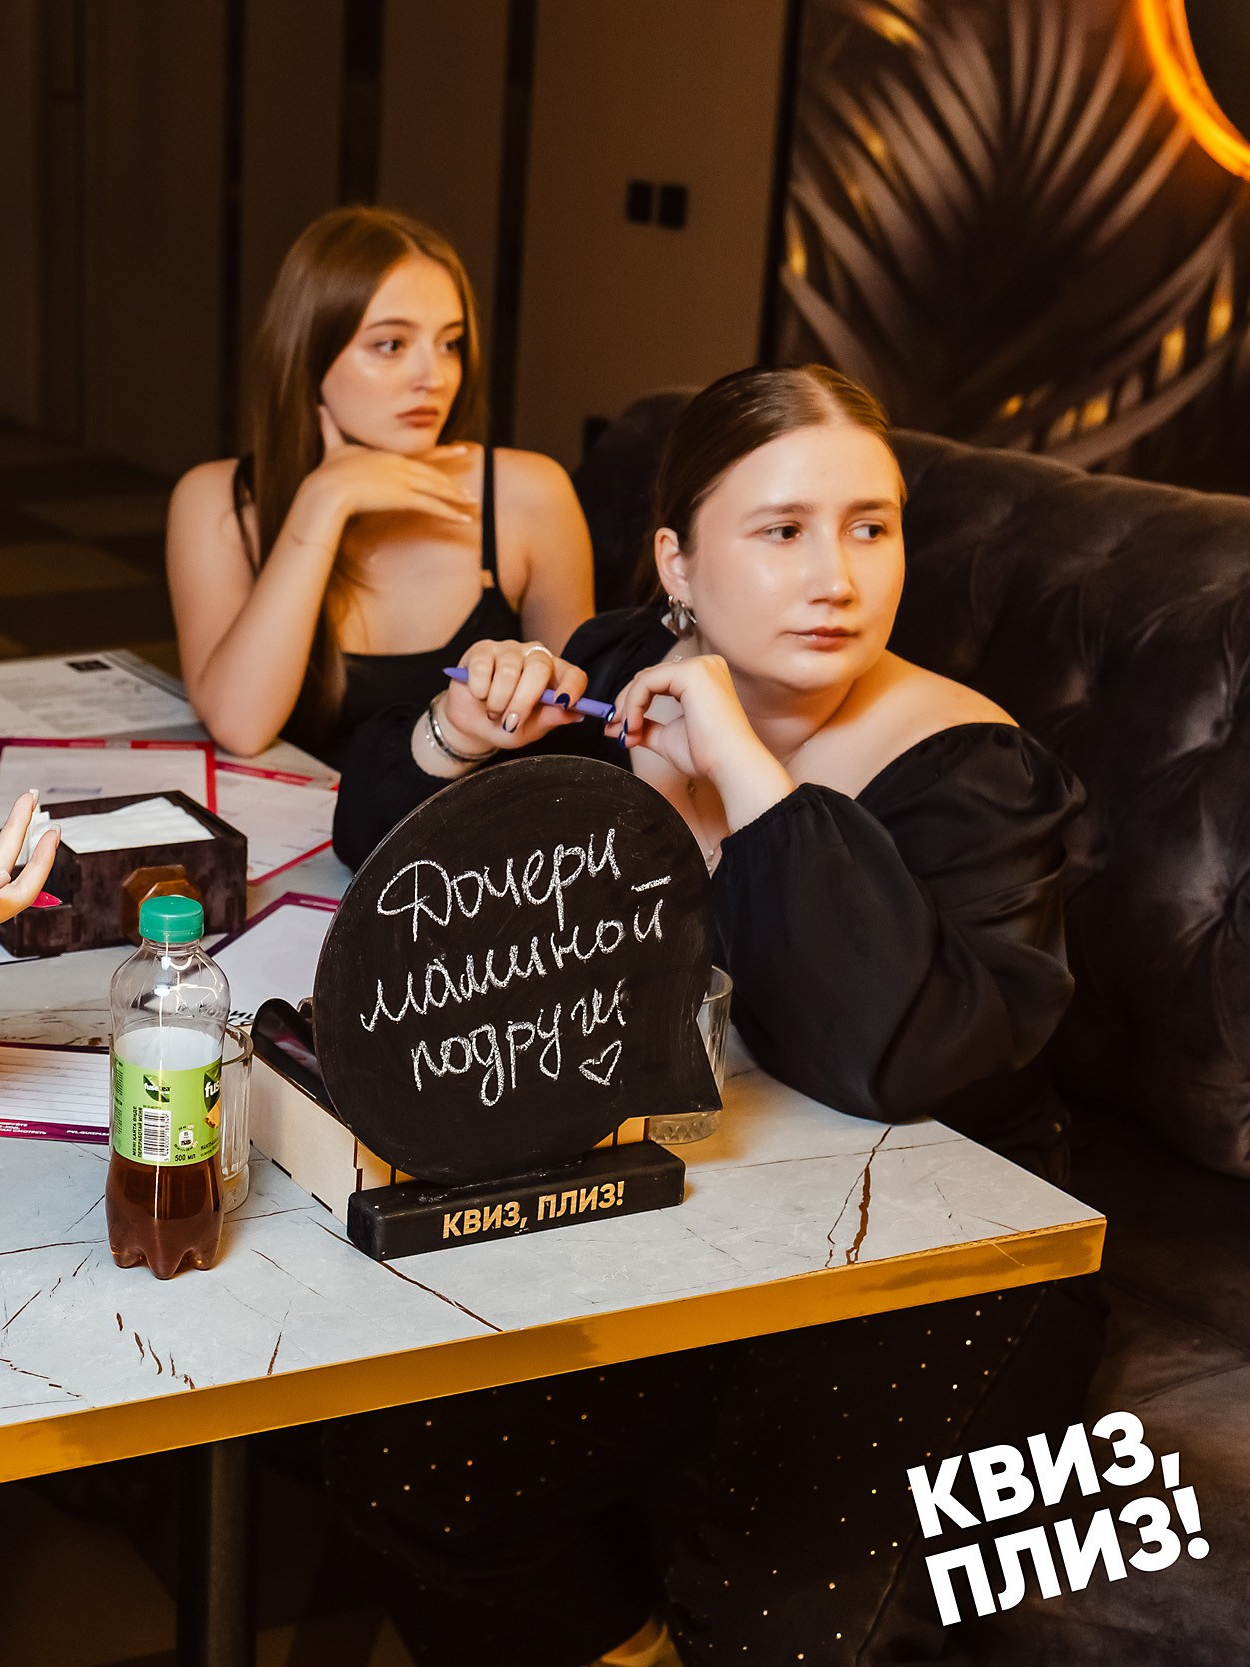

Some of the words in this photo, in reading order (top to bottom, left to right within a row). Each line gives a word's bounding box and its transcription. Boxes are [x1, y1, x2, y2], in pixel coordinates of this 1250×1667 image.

[377, 828, 622, 941] Дочери
[410, 977, 627, 1106] подруги
[175, 1154, 186, 1162] 500
[442, 1201, 527, 1239] КВИЗ,
[537, 1181, 624, 1221] ПЛИЗ!
